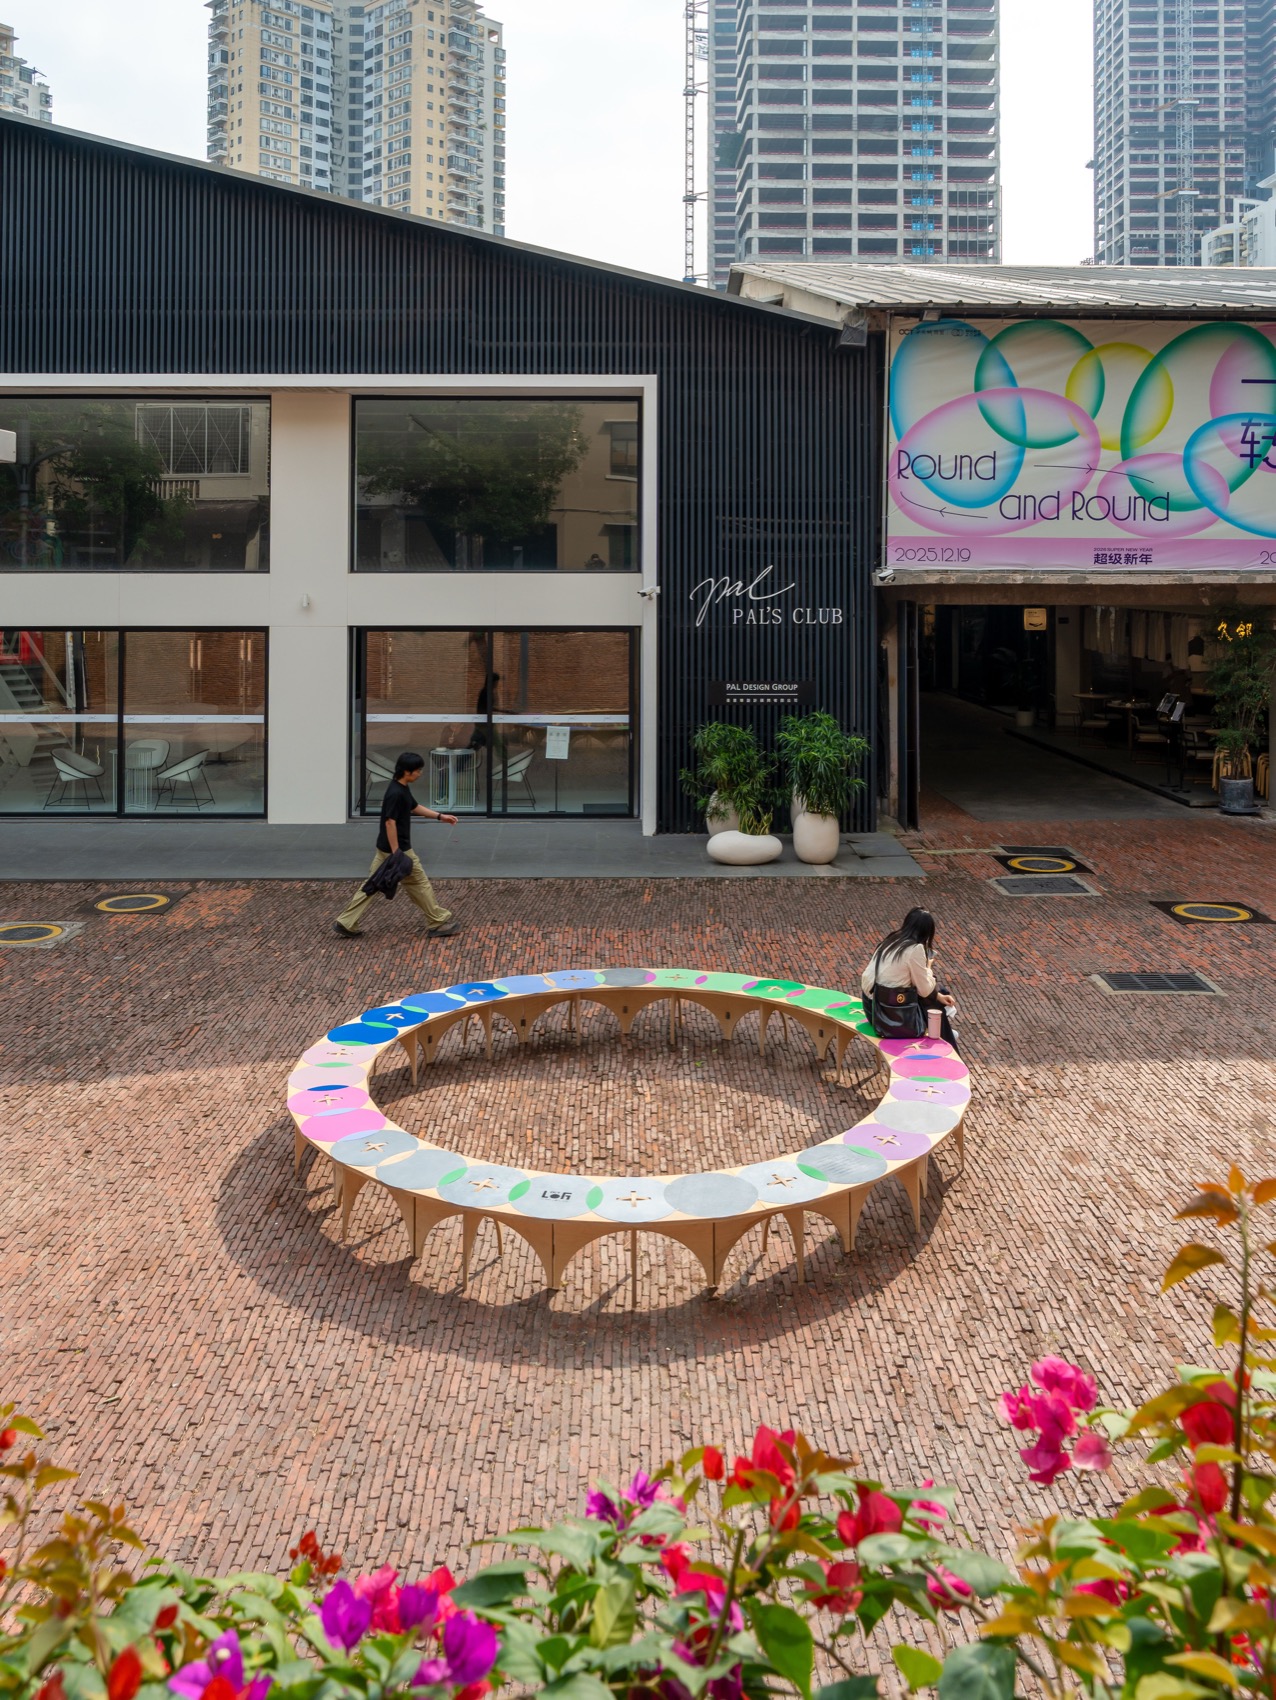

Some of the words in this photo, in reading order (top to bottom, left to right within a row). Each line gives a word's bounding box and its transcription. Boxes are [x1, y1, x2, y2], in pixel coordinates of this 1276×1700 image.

[897, 450, 997, 481] Round
[999, 490, 1060, 521] and
[1072, 490, 1170, 522] Round
[894, 547, 972, 562] 2025.12.19
[1093, 552, 1153, 565] 超级新年
[732, 606, 782, 625] PAL'S
[792, 607, 843, 625] CLUB
[726, 683, 741, 691] PAL
[742, 683, 770, 691] DESIGN
[771, 683, 798, 691] GROUP
